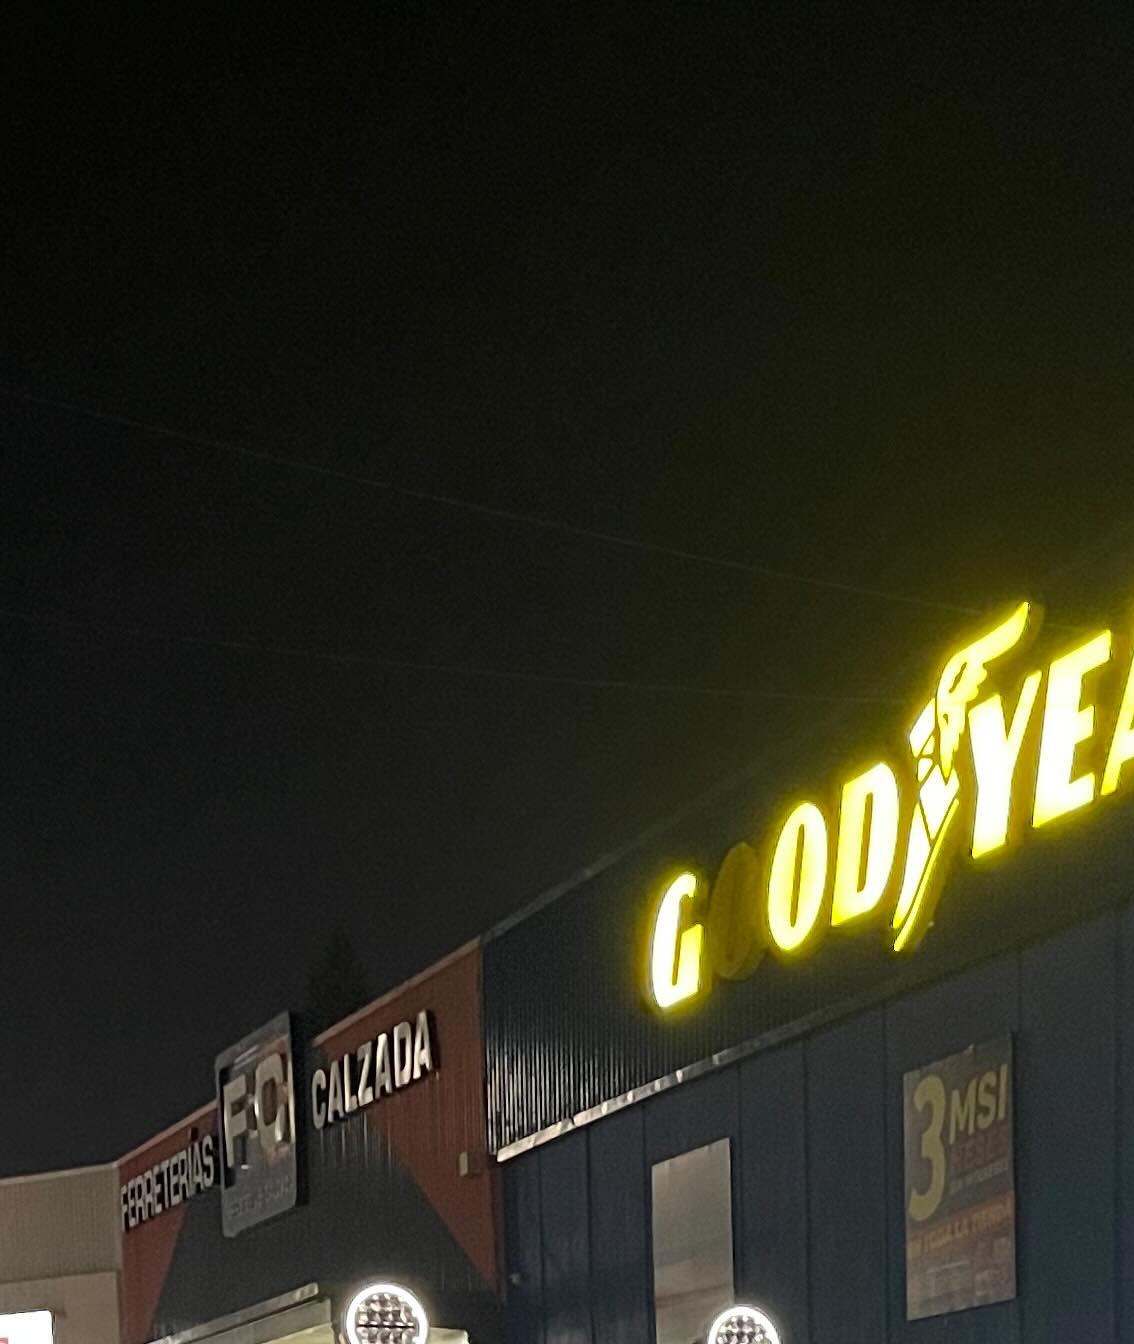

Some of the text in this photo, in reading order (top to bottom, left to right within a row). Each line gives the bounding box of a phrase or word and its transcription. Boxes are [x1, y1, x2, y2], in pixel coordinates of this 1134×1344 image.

[311, 1008, 433, 1130] CALZADA
[908, 1063, 1009, 1222] 3 MSI
